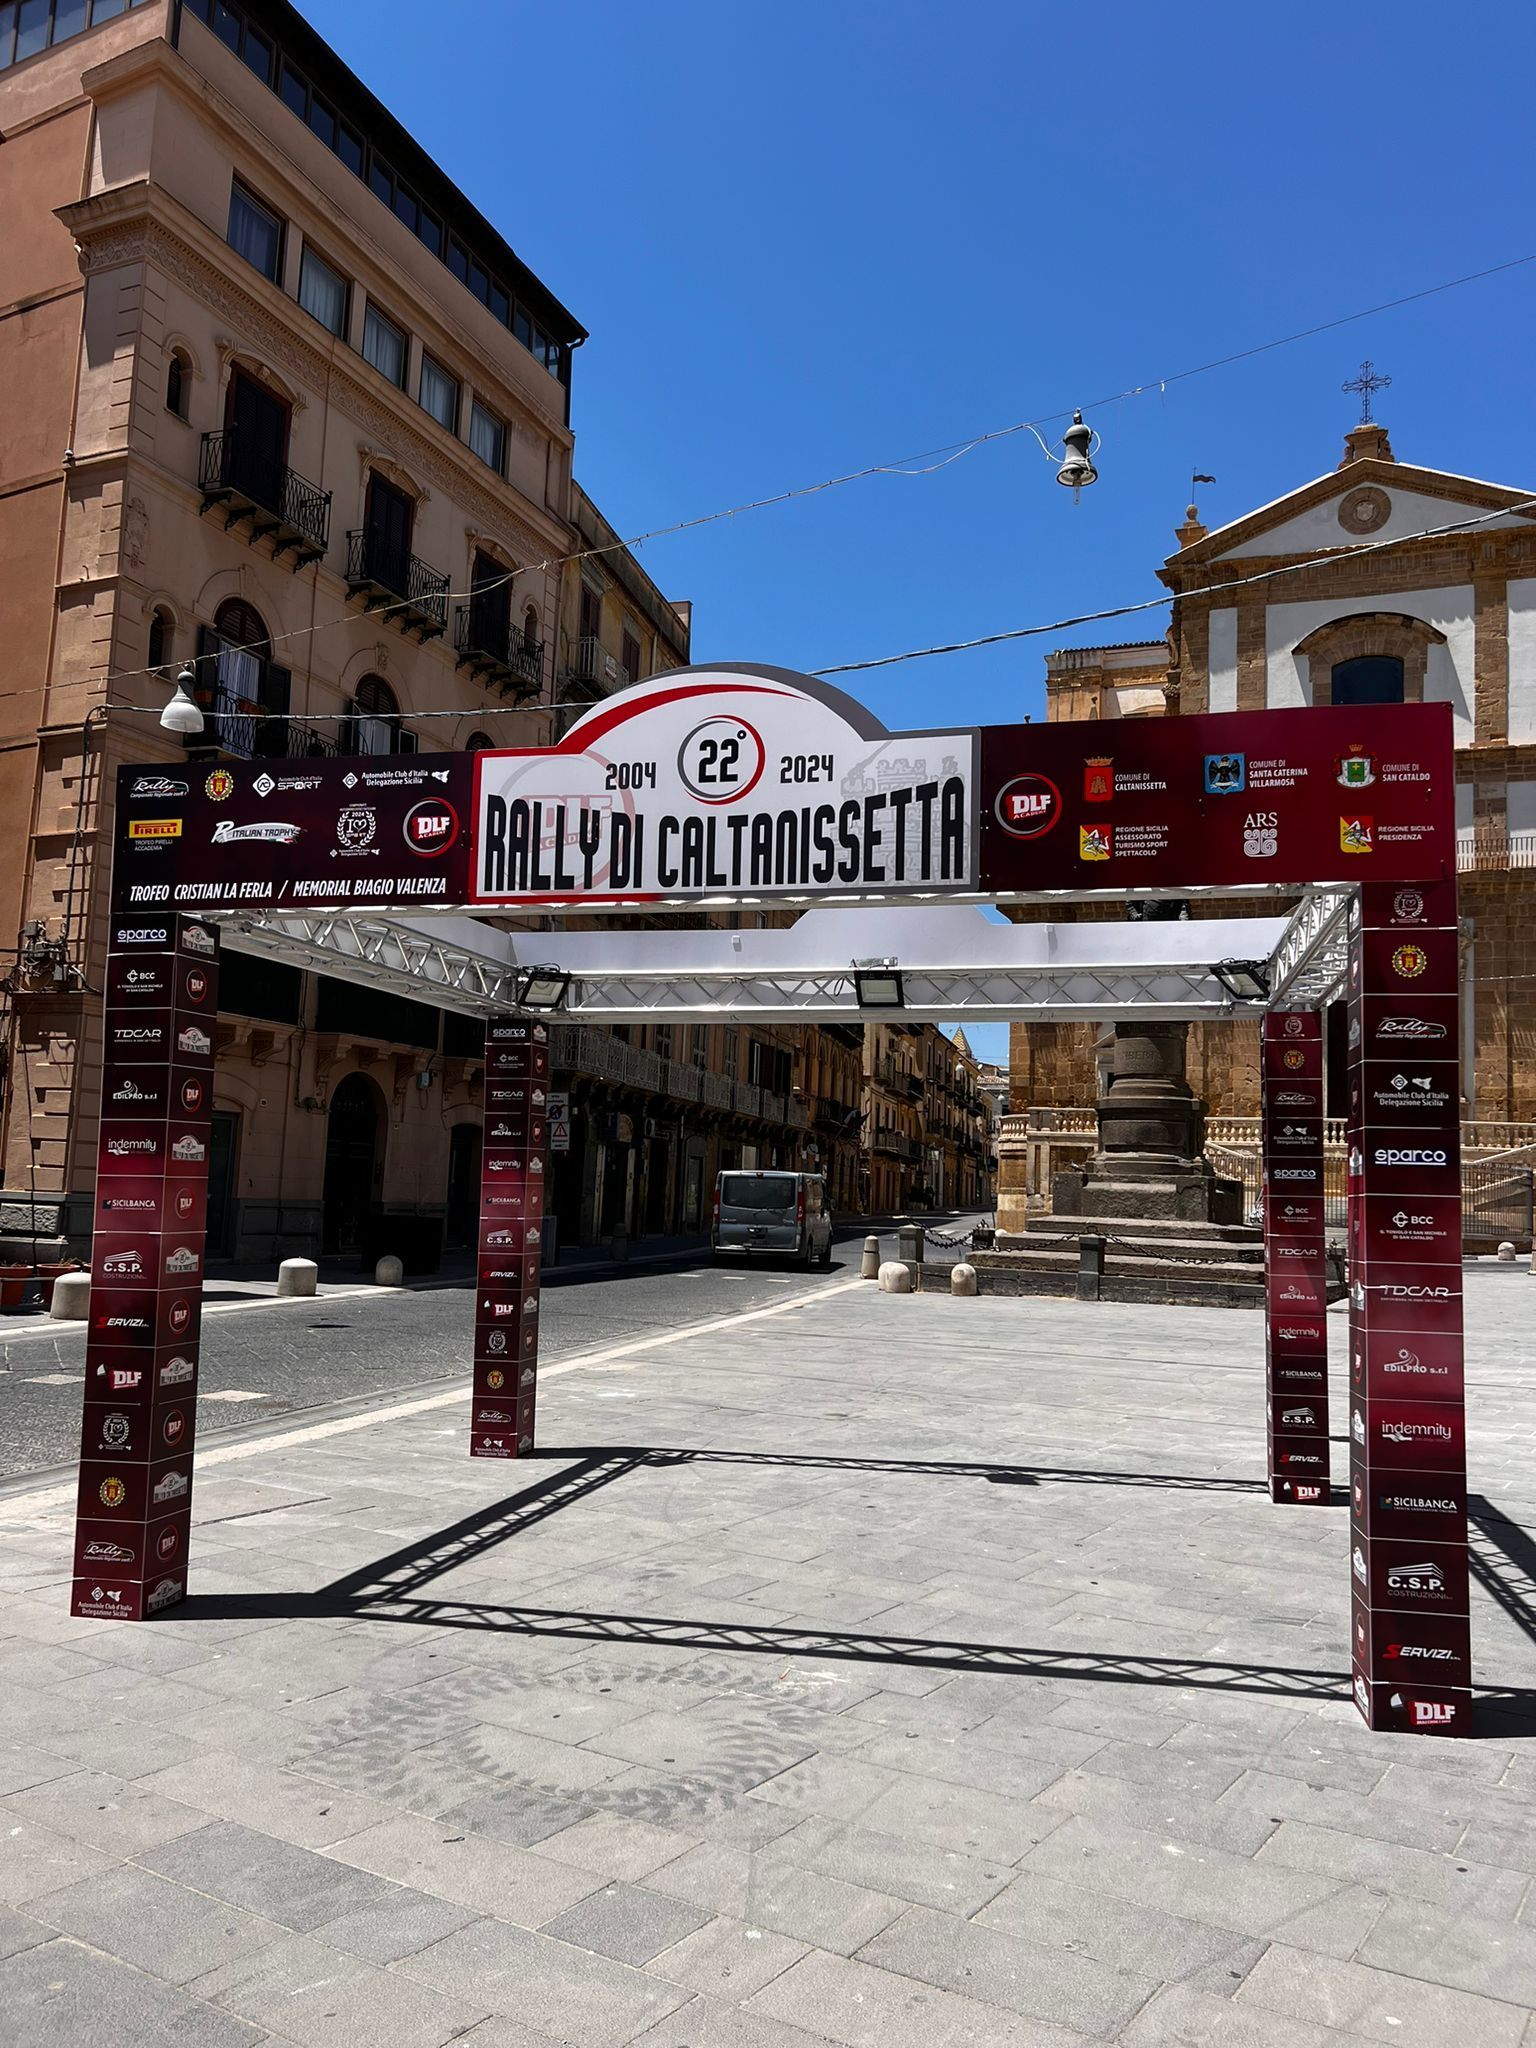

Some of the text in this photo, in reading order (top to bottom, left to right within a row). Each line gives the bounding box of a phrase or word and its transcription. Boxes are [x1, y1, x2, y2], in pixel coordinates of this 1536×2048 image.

[780, 754, 834, 783] 2024
[1249, 759, 1286, 769] COMUNE DI
[1382, 763, 1420, 773] COMUNE DI
[361, 771, 394, 780] Automobile
[395, 770, 408, 778] Club
[605, 761, 657, 790] 2004
[1114, 773, 1150, 783] COMUNE DI
[1249, 768, 1308, 779] SANTA CATERINA
[1382, 772, 1431, 782] SAN CATALDO
[134, 779, 176, 793] Rally
[366, 777, 423, 788] Delegazione Sicilia
[1114, 781, 1167, 792] CALTANISSETTA
[1249, 778, 1295, 788] VILLARMOSA
[1012, 794, 1051, 815] DLF
[417, 816, 450, 835] DLF
[1243, 812, 1278, 828] ARS
[134, 823, 178, 835] PIRELLI
[232, 828, 262, 838] ITALIAN
[264, 828, 294, 838] TROPHY
[484, 776, 965, 892] RALLY DI CALTANISSETTA
[1115, 833, 1162, 841] ASSESSORATO
[1146, 841, 1168, 849] SPORT
[129, 885, 170, 901] TROFEO
[174, 883, 223, 900] CRISTIAN
[223, 883, 237, 899] LA
[239, 881, 273, 898] FERLA
[292, 880, 350, 897] MEMORIAL
[353, 878, 394, 896] BIAGIO
[396, 877, 447, 895] VALENZA
[117, 928, 167, 944] sparco
[139, 972, 156, 980] BCC
[1380, 1021, 1430, 1034] Rally
[114, 1029, 162, 1038] TDCAR
[113, 1092, 143, 1100] EDILPRO
[1373, 1091, 1411, 1099] Automobile
[1426, 1092, 1449, 1100] d'Italia
[1379, 1099, 1443, 1107] Delegazione Sicilia
[108, 1138, 157, 1152] indemnity
[1375, 1149, 1447, 1165] sparco
[1274, 1169, 1316, 1178] sparco
[112, 1199, 156, 1208] SICILBANCA
[1411, 1216, 1434, 1225] BCC
[487, 1236, 513, 1244] C.S.P.
[103, 1262, 143, 1273] C.S.P.
[495, 1304, 514, 1314] DLF
[95, 1317, 144, 1328] SERVIZI
[1279, 1327, 1319, 1337] indemnity
[1285, 1370, 1323, 1378] SICILBANCA
[1384, 1363, 1427, 1374] EDILPRO
[113, 1370, 142, 1385] DLF
[1282, 1415, 1316, 1424] C.S.P.
[1382, 1420, 1452, 1439] indemnity
[1297, 1486, 1321, 1498] DLF
[1393, 1496, 1457, 1510] SICILBANCA
[87, 1543, 122, 1557] Rally
[1388, 1576, 1445, 1591] C.S.P.
[1387, 1589, 1446, 1600] COSTRUZIONI
[105, 1602, 116, 1610] Club
[1382, 1644, 1452, 1660] SERVIZI
[1414, 1701, 1456, 1720] DLF
